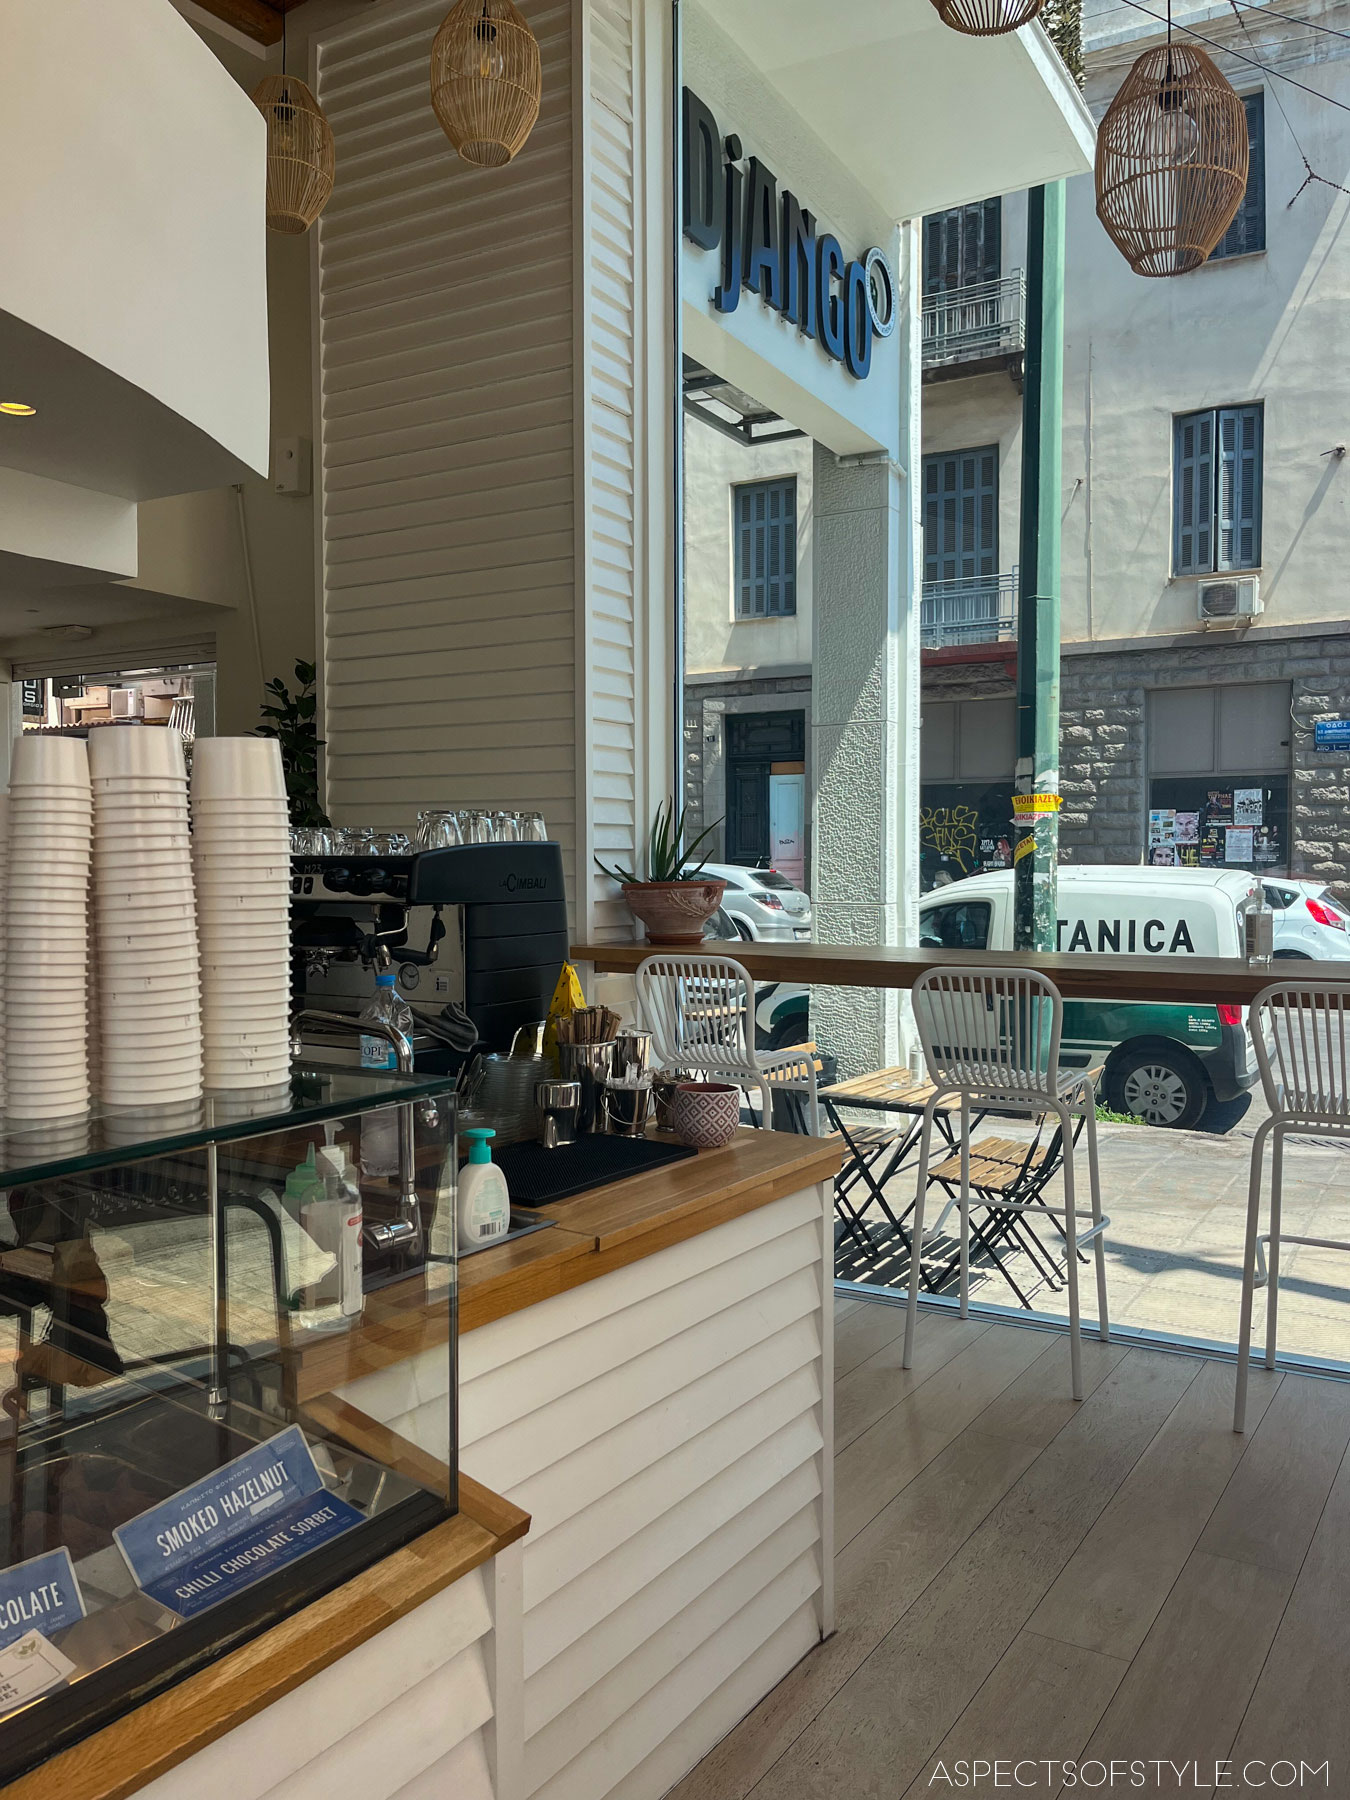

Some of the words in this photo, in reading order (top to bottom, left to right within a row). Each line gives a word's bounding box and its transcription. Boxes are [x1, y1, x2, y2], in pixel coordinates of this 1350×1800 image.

[156, 1504, 220, 1557] SMOKED
[220, 1461, 290, 1518] HAZELNUT
[175, 1570, 223, 1600] CHILLI
[219, 1531, 294, 1575] CHOCOLATE
[290, 1505, 338, 1537] SORBET
